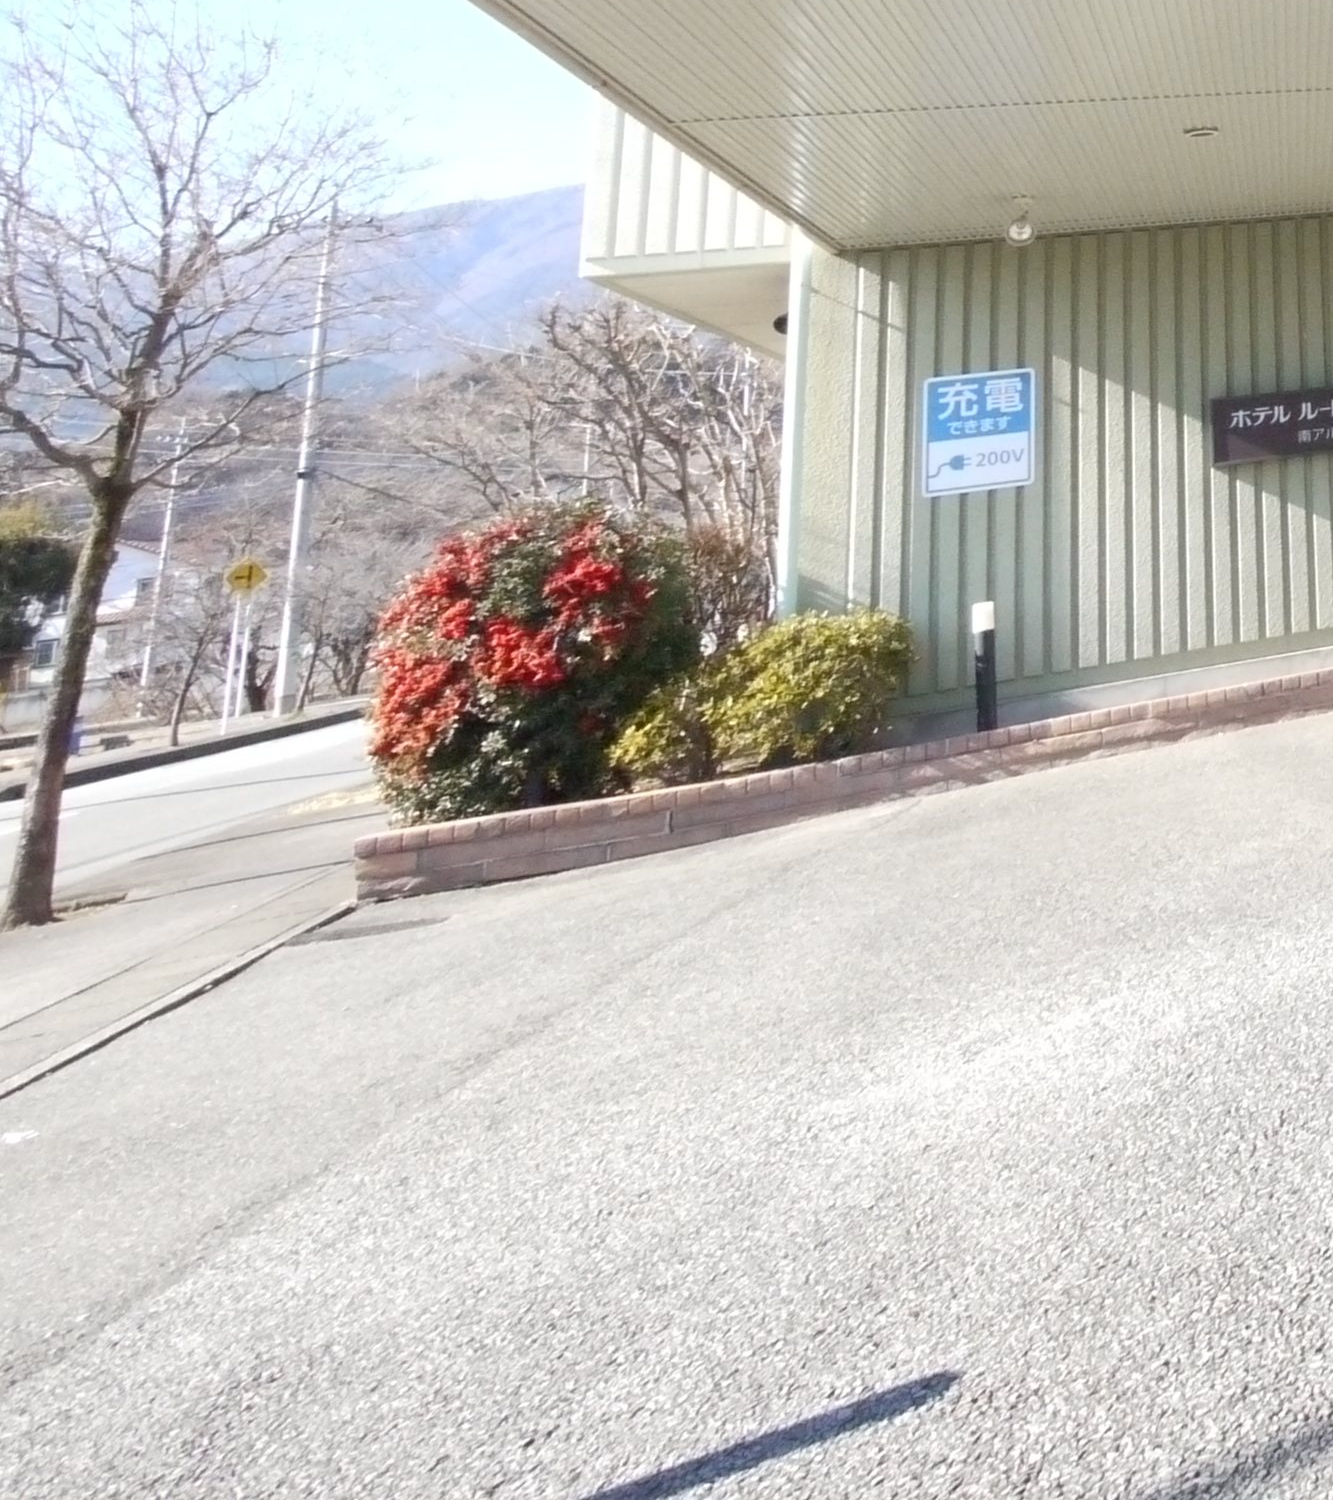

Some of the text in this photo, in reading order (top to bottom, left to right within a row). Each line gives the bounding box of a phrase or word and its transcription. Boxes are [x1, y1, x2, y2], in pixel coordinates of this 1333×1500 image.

[937, 377, 1024, 420] 充電
[947, 415, 1012, 435] できます
[1229, 404, 1292, 429] ホテル
[975, 448, 1025, 467] 200V
